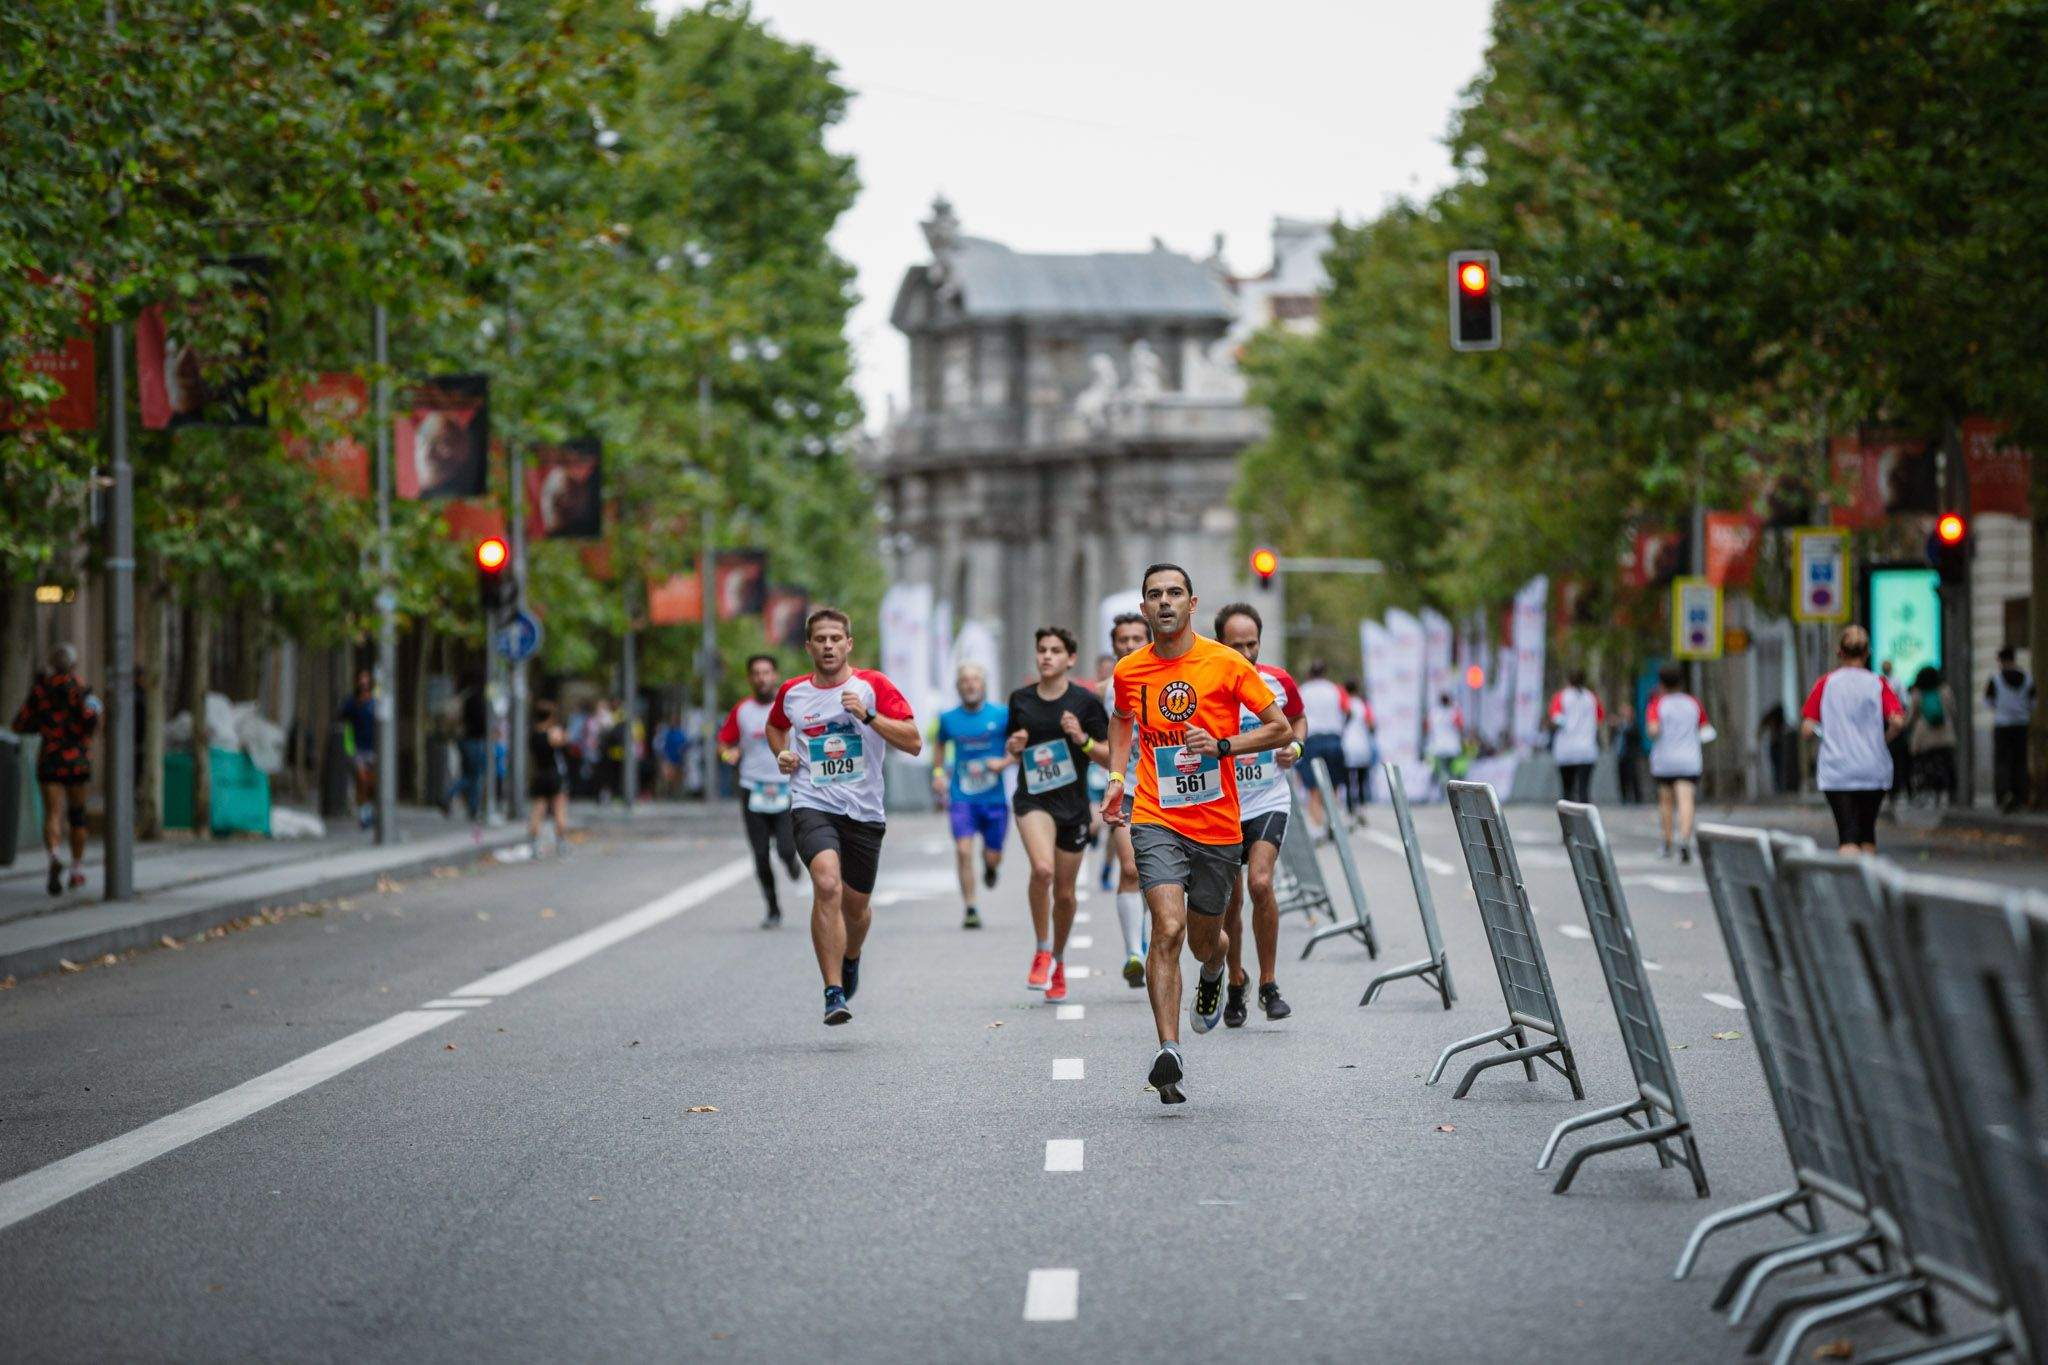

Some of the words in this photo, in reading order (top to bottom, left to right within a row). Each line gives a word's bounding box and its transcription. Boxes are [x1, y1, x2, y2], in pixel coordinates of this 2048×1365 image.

[1166, 682, 1189, 692] BEER
[1161, 703, 1196, 721] RUNNERS
[821, 758, 854, 776] 1029
[1037, 764, 1061, 782] 260
[1236, 765, 1262, 781] 303
[1176, 773, 1206, 794] 561
